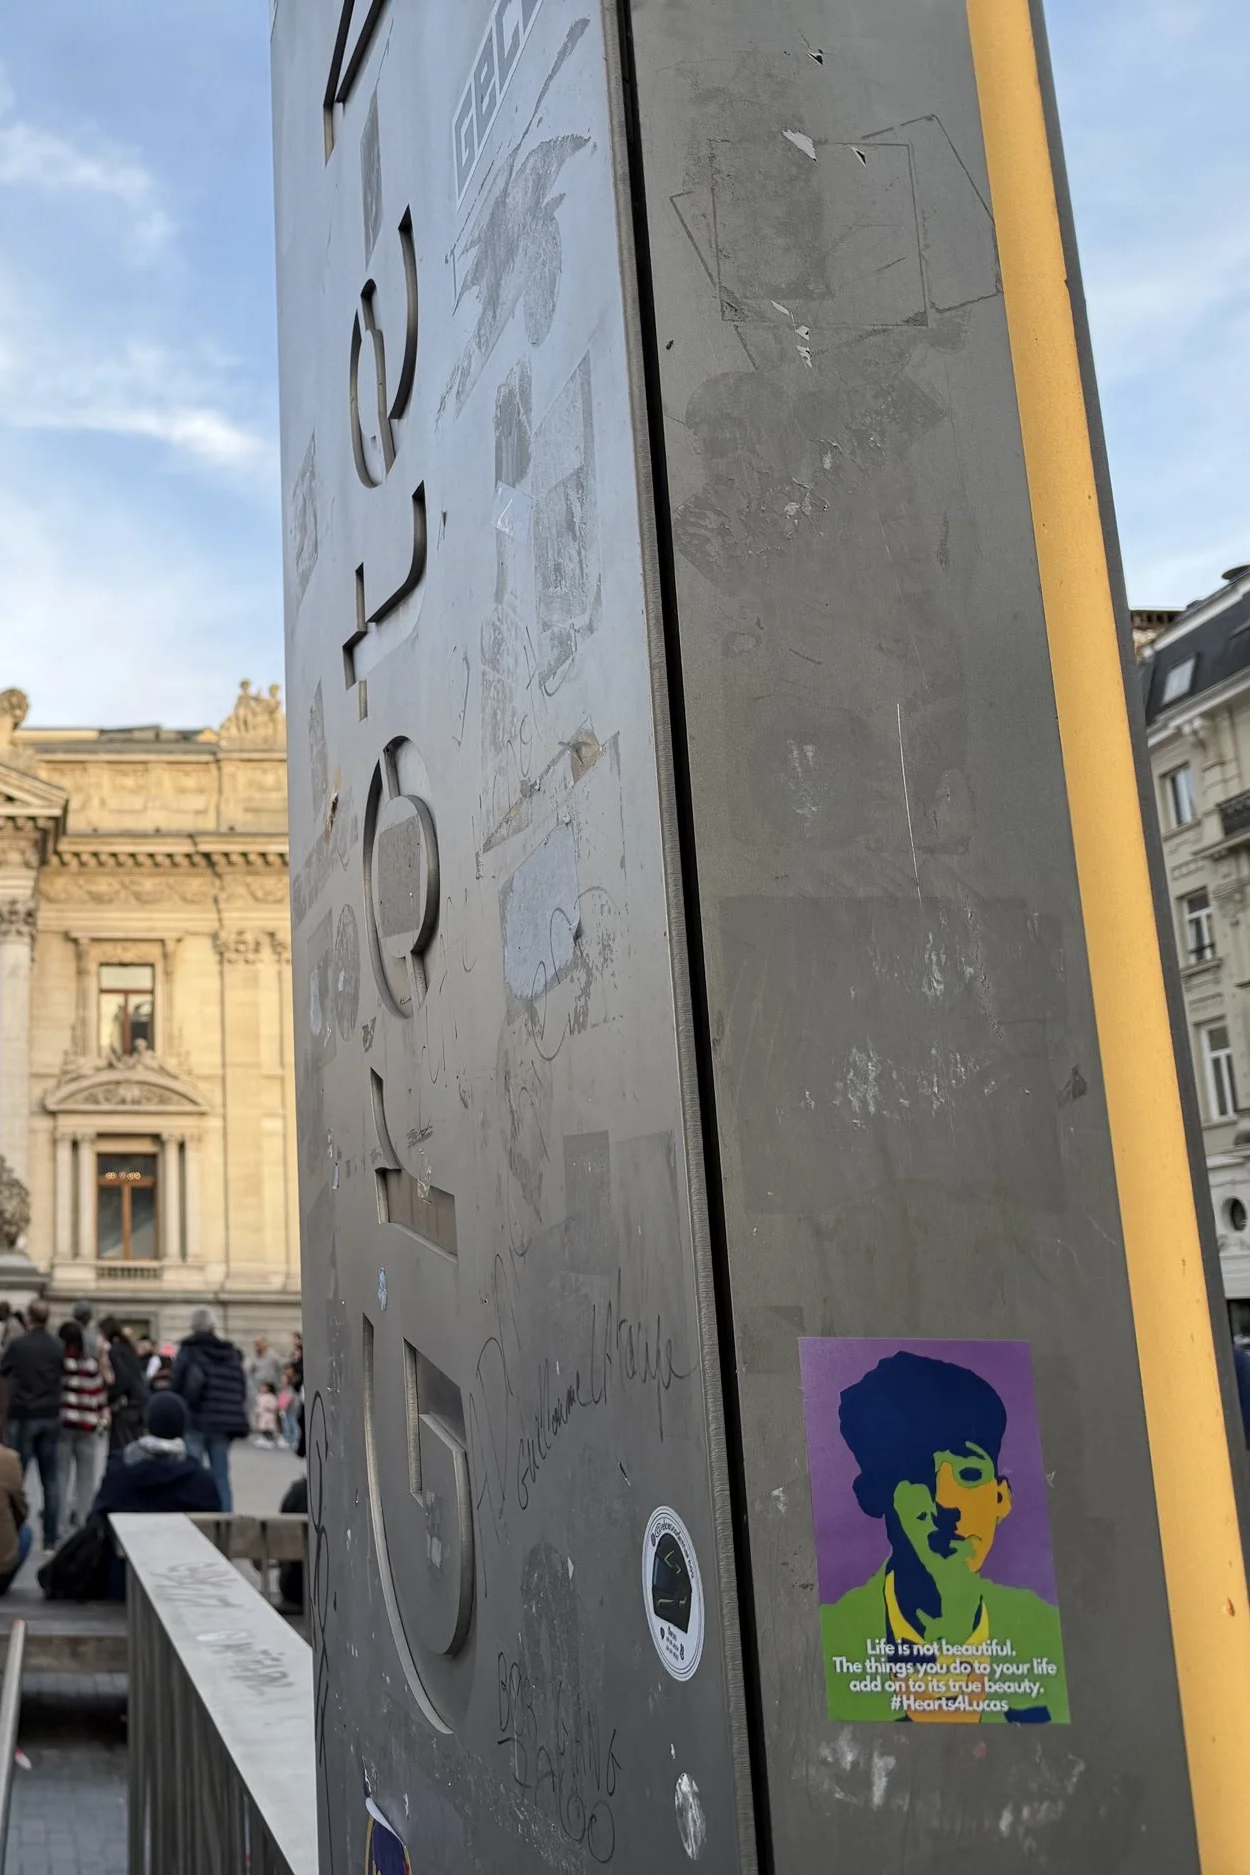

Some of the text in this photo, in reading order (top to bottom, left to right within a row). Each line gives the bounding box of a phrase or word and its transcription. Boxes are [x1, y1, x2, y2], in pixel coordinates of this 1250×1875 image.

[866, 1638, 1016, 1656] Life is not beautiful.
[833, 1656, 1058, 1680] The things you do to your life
[849, 1676, 1045, 1698] add on to its true beauty.
[890, 1695, 1009, 1712] #Hearts4Lucas
